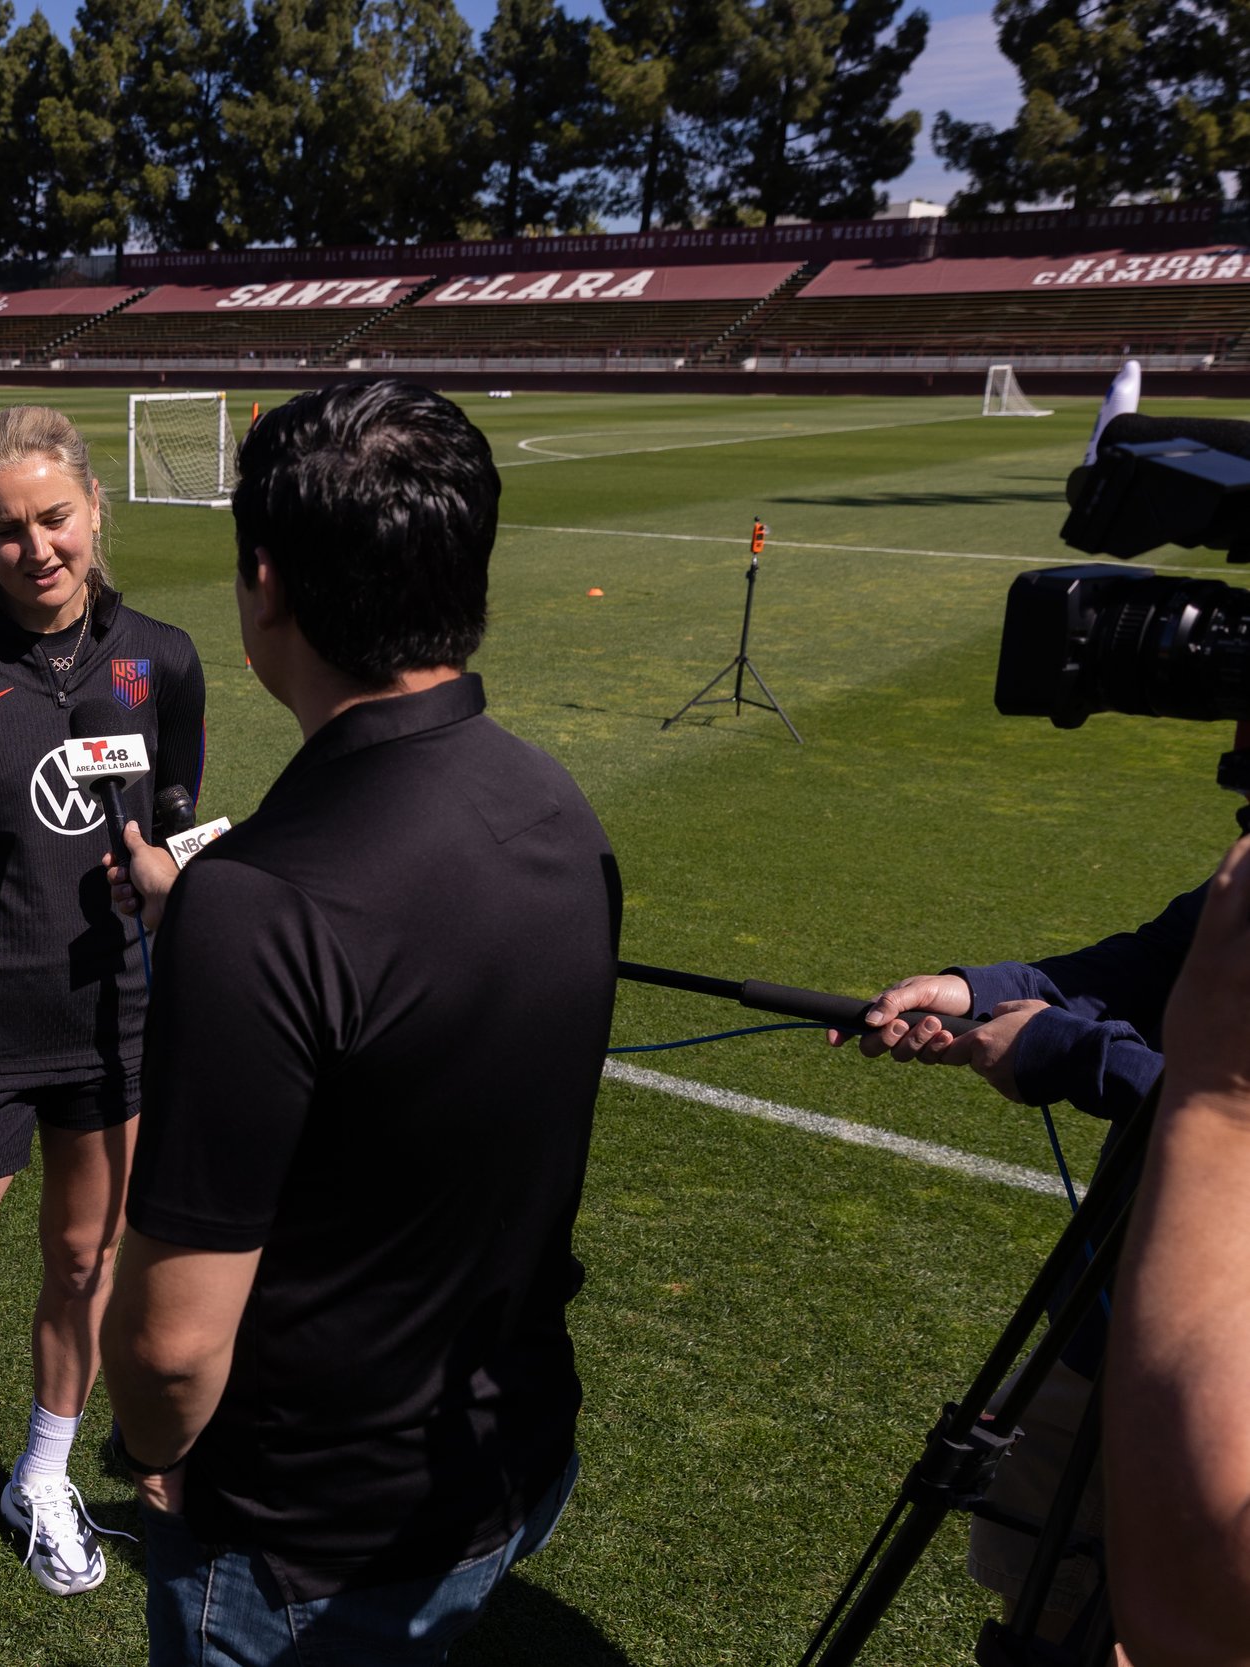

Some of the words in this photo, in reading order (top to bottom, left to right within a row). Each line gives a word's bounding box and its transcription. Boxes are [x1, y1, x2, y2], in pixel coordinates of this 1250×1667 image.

[415, 246, 455, 259] LESLIE
[460, 243, 513, 257] OSBORNE
[536, 239, 599, 253] DANIELLE
[604, 236, 655, 251] SLATON
[672, 233, 714, 248] JULIE
[720, 232, 758, 246] ERTZ
[775, 226, 824, 243] TERRY
[1152, 206, 1212, 225] PALIC
[1067, 253, 1249, 273] NATIONA
[216, 278, 402, 308] SANTA
[435, 270, 656, 302] CLARA
[115, 661, 147, 681] USA
[105, 748, 129, 761] 48
[76, 763, 96, 773] ÁREA
[108, 762, 118, 770] LA
[119, 760, 142, 769] BAHÍA
[172, 832, 207, 859] NBC
